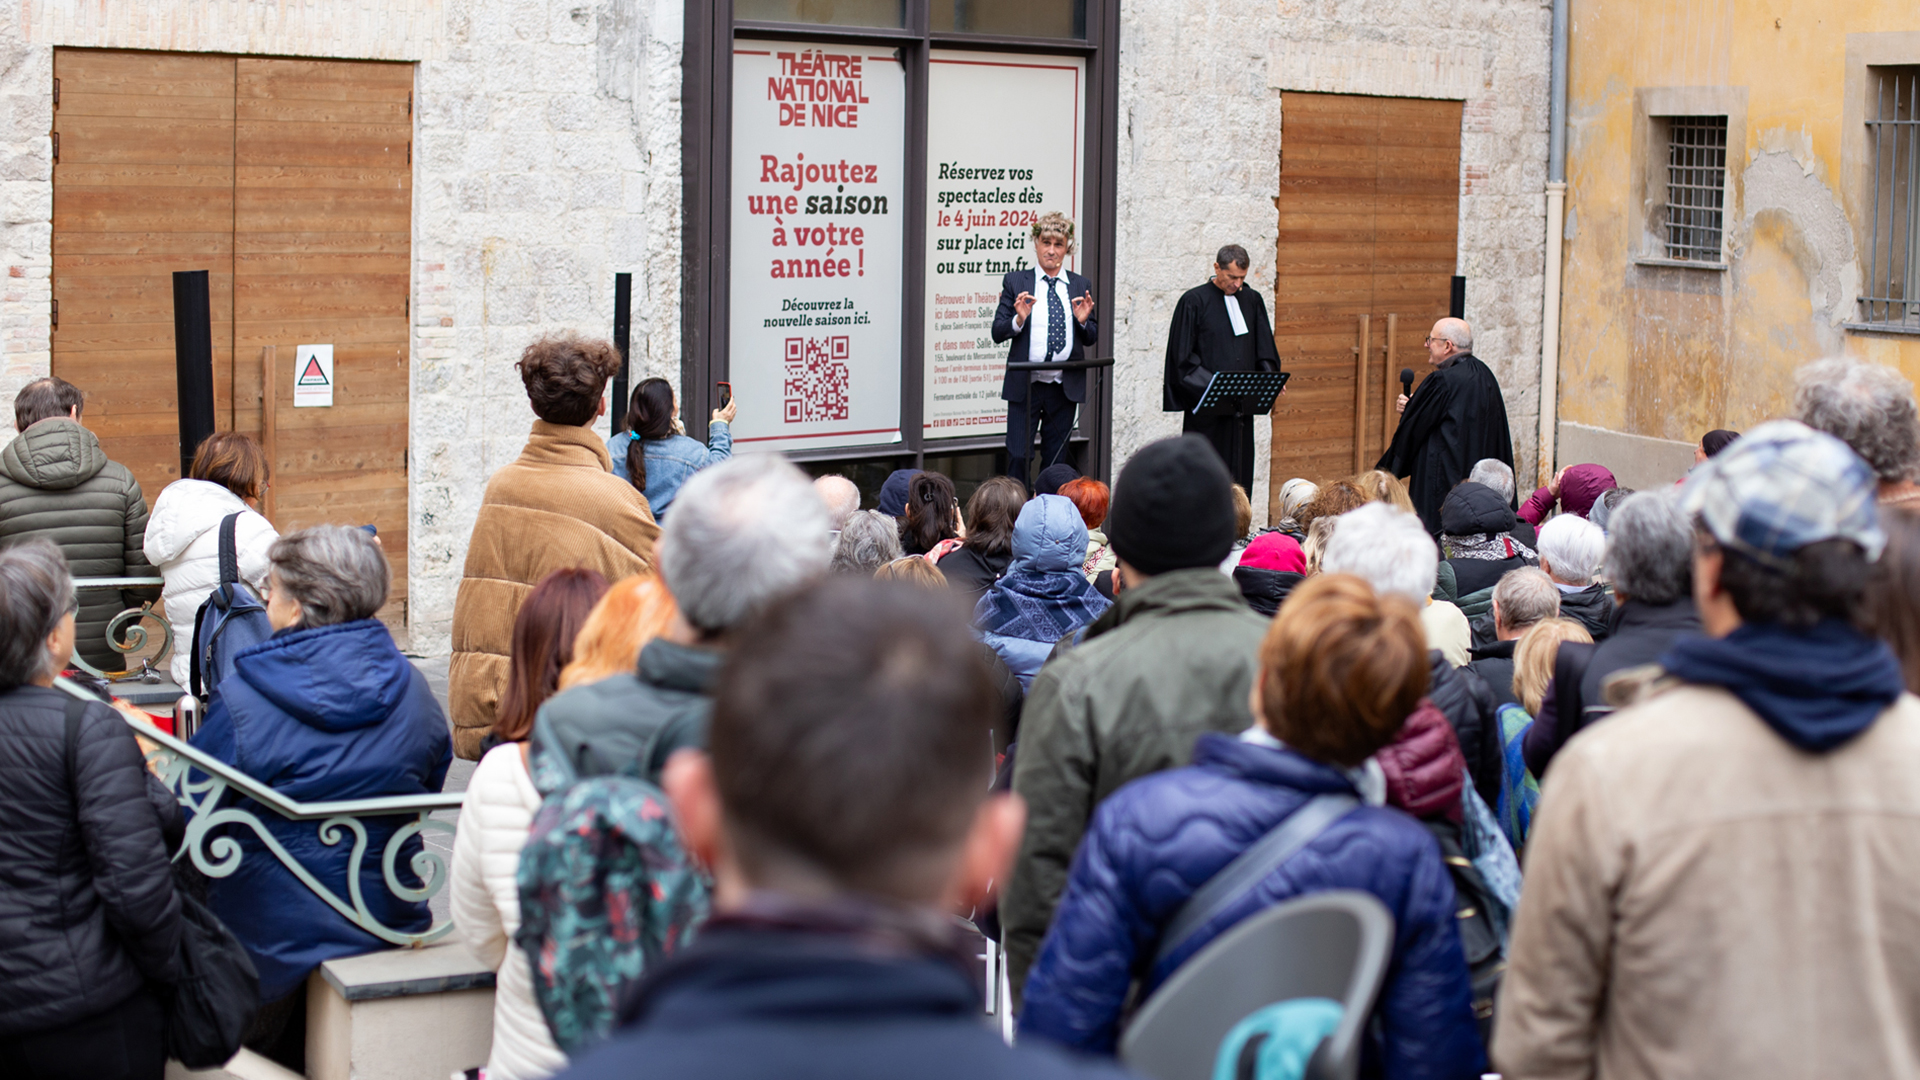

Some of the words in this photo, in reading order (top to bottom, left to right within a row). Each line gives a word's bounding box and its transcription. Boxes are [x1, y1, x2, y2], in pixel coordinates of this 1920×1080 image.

[777, 49, 862, 78] THÉÂTRE
[768, 77, 869, 104] NATIONAL
[779, 103, 806, 127] DE
[812, 104, 858, 128] NICE
[760, 152, 878, 192] Rajoutez
[938, 161, 1005, 180] Réservez
[1008, 168, 1033, 180] vos
[748, 195, 798, 215] une
[805, 184, 888, 215] saison
[937, 187, 1016, 208] spectacles
[1018, 186, 1043, 204] dès
[772, 215, 786, 247] à
[793, 222, 864, 247] votre
[937, 210, 951, 227] le
[954, 209, 963, 227] 4
[964, 209, 996, 232] juin
[999, 210, 1038, 227] 2024
[937, 238, 962, 251] sur
[964, 234, 1003, 254] place
[1006, 232, 1025, 250] ici
[770, 246, 851, 279] année
[937, 262, 954, 274] ou
[958, 261, 982, 274] sur
[985, 256, 1028, 273] tnn.fr
[782, 297, 842, 312] Découvrez
[844, 298, 854, 310] la
[935, 293, 965, 305] Retrouvez
[967, 292, 973, 304] le
[974, 292, 997, 304] Théâtre
[763, 314, 812, 327] nouvelle
[815, 312, 851, 326] saison
[854, 311, 871, 325] ici.
[935, 308, 943, 319] ici
[944, 308, 959, 319] dans
[961, 309, 976, 319] notre
[978, 306, 993, 318] Salle
[934, 342, 941, 351] et
[942, 339, 958, 351] dans
[959, 340, 975, 350] notre
[976, 337, 992, 349] Salle
